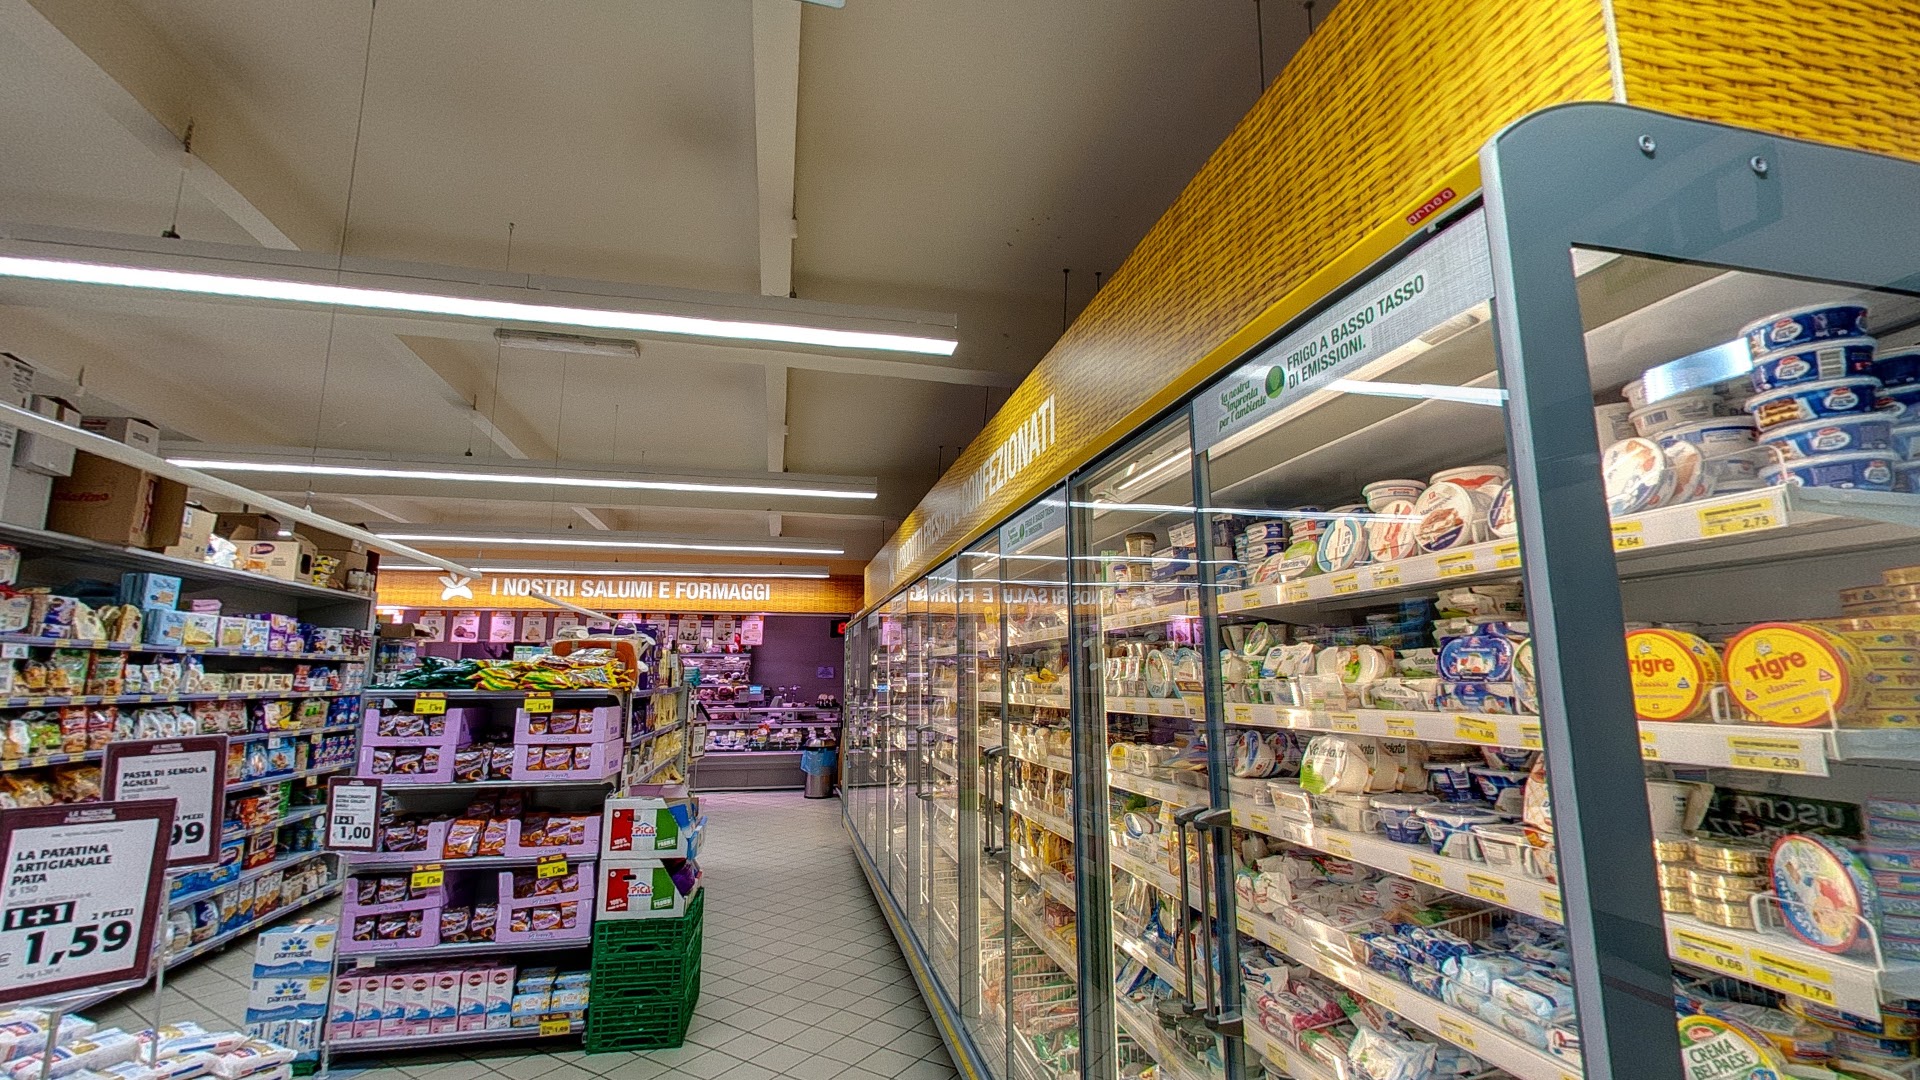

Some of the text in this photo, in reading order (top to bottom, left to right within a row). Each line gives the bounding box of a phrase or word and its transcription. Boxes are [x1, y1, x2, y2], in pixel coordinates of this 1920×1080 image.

[1287, 275, 1424, 371] FRIGO A BASSO TASSO
[1288, 335, 1367, 389] DI EMISSIONI.
[1219, 416, 1230, 432] per
[490, 577, 770, 601] I NOSTRI SALUMI E FORMAGGI
[1745, 652, 1807, 680] Tigre
[123, 766, 207, 779] PASTA DI SEMOLA
[122, 778, 158, 788] AGNESI
[182, 812, 204, 821] PEZZI
[341, 826, 371, 840] 1,00
[17, 844, 109, 862] LA PATATINA
[14, 855, 112, 874] ARTIGIANALE
[12, 873, 47, 886] PATA
[10, 903, 70, 929] 1+1
[102, 908, 134, 919] PEZZI
[26, 920, 133, 966] 1,59
[273, 949, 313, 960] parmalat
[267, 993, 307, 1005] parmalat
[1689, 1037, 1738, 1064] CREMA
[1691, 1050, 1755, 1080] BELPAESE
